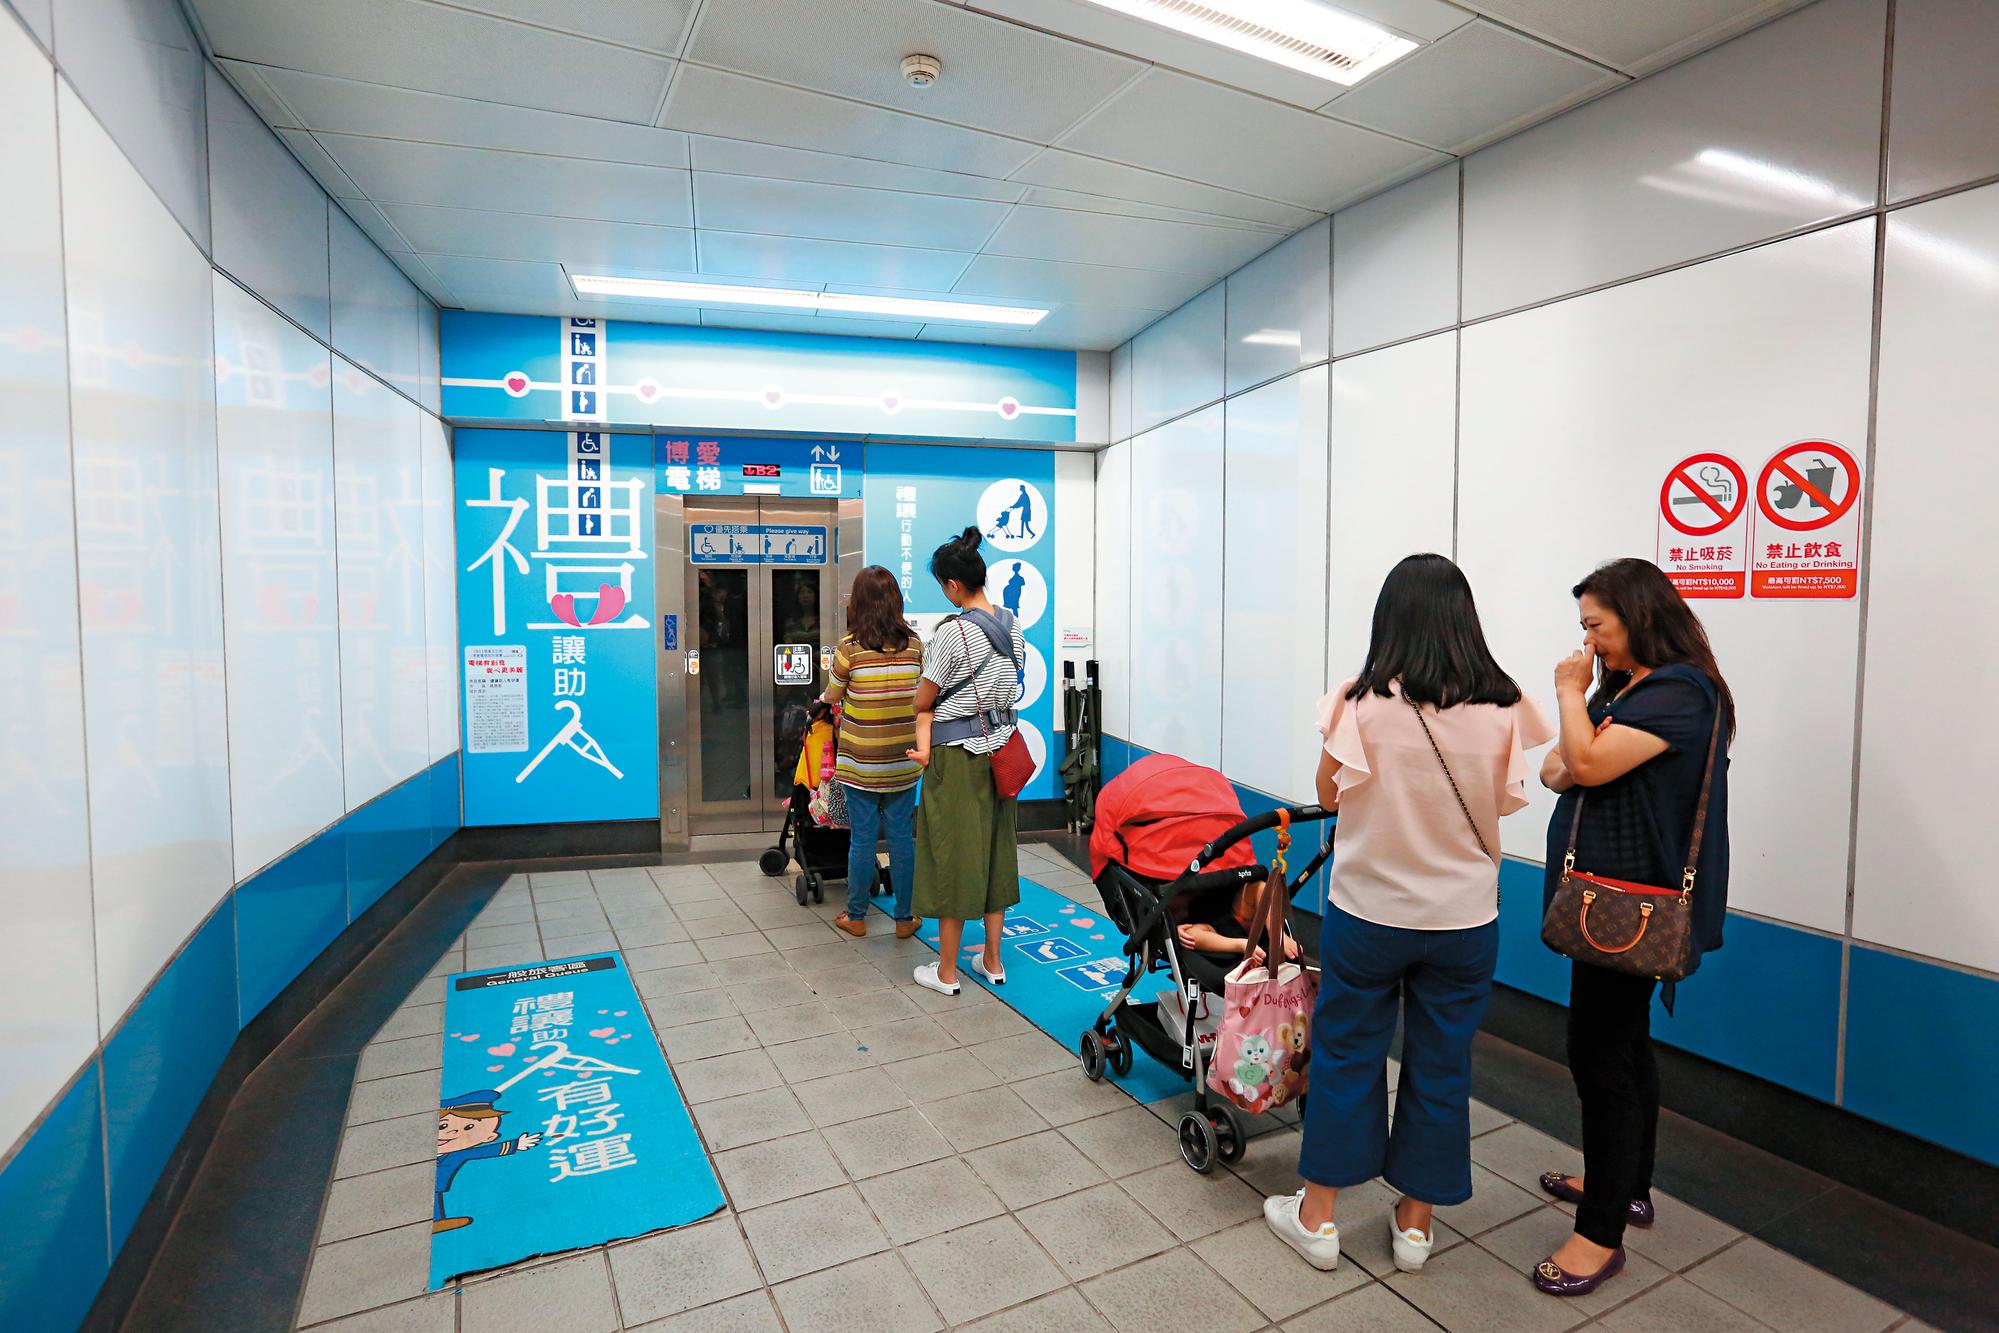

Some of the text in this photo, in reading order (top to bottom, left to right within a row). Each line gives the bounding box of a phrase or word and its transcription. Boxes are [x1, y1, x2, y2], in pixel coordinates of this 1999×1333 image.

[665, 441, 721, 465] 博愛
[665, 466, 721, 491] 電梯
[765, 527, 784, 535] Please
[1669, 546, 1733, 562] 禁止吸菸
[1766, 541, 1842, 559] 禁止飲食
[1688, 563, 1723, 572] Smoking
[1770, 561, 1798, 570] Eating
[1813, 560, 1853, 569] Drinking
[1670, 577, 1735, 586] 高可罰NT$10,000
[486, 961, 587, 980] 一般旅客區
[486, 967, 589, 987] General Queue
